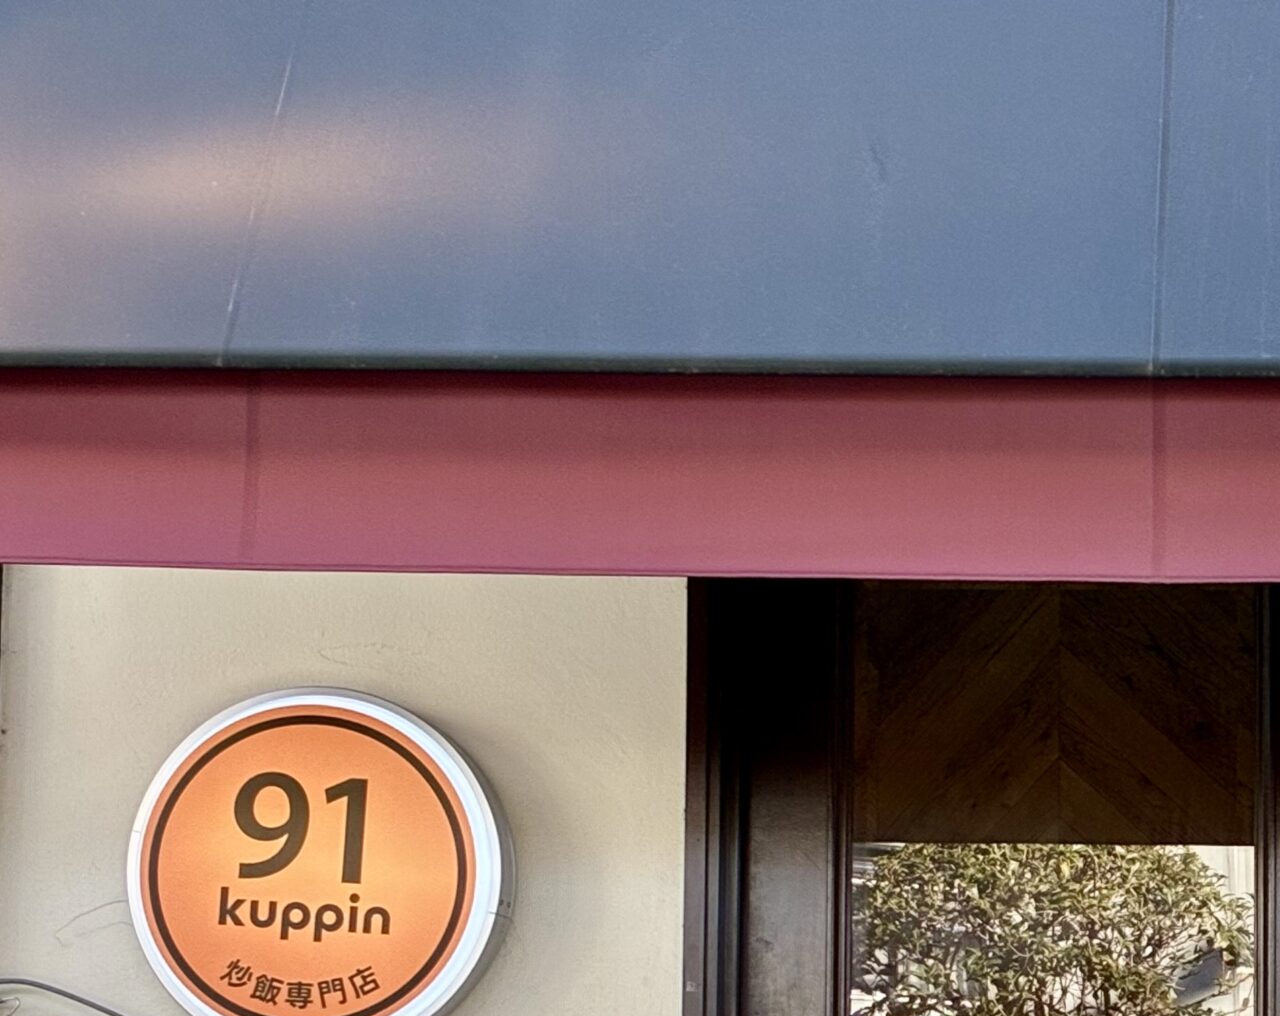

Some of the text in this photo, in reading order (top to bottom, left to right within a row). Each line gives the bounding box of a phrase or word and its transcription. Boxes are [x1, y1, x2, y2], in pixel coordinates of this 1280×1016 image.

[233, 771, 369, 885] 91
[217, 886, 391, 943] kuppin
[219, 958, 381, 1010] 炒飯専門店
